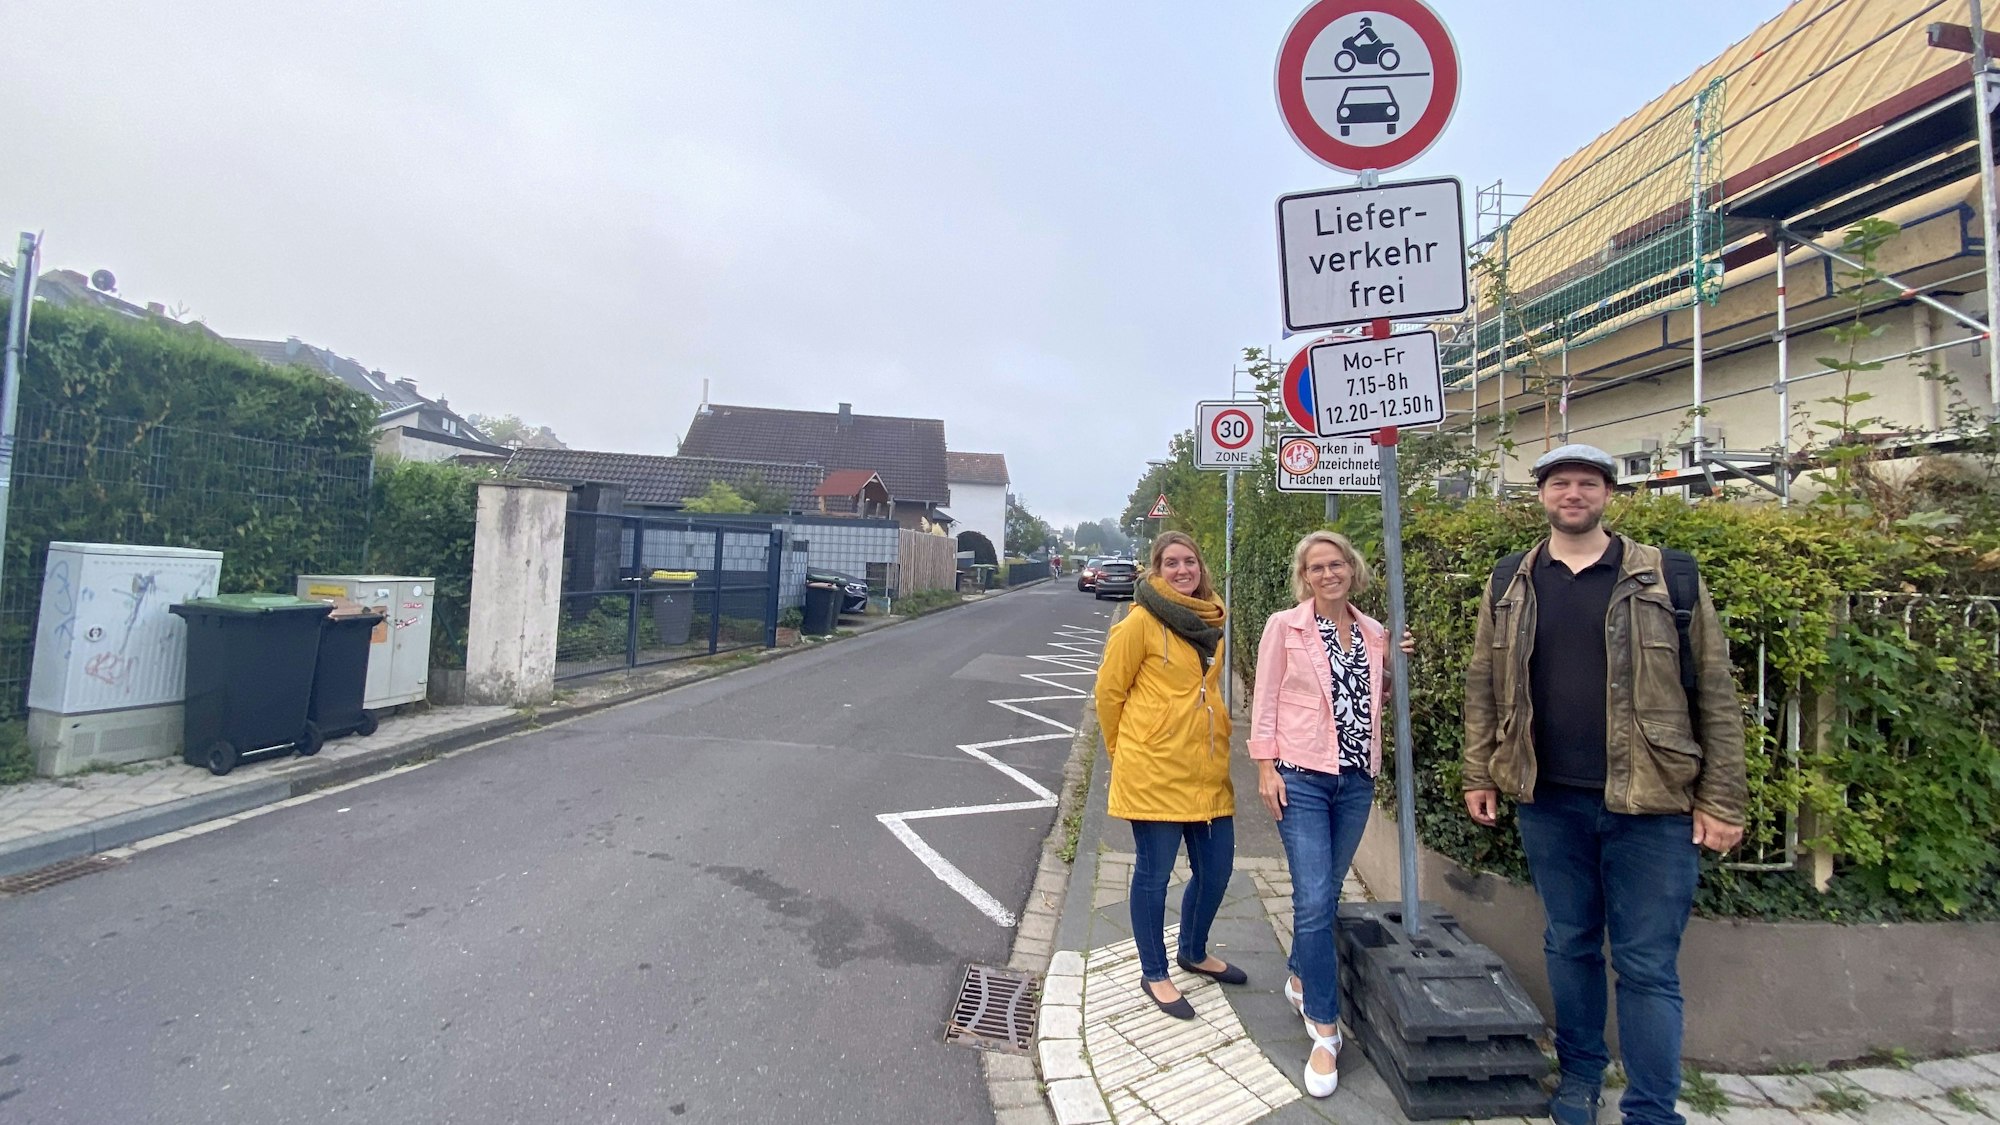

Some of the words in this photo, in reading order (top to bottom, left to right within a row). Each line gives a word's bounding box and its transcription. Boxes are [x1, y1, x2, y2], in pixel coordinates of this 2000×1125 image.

[1315, 202, 1427, 237] Liefer-
[1309, 237, 1438, 275] verkehr
[1350, 275, 1404, 308] frei
[1343, 347, 1405, 372] Mo-Fr
[1220, 420, 1245, 439] 30
[1215, 451, 1248, 462] ZONE
[1353, 442, 1364, 455] in
[1339, 473, 1381, 486] erlaubt
